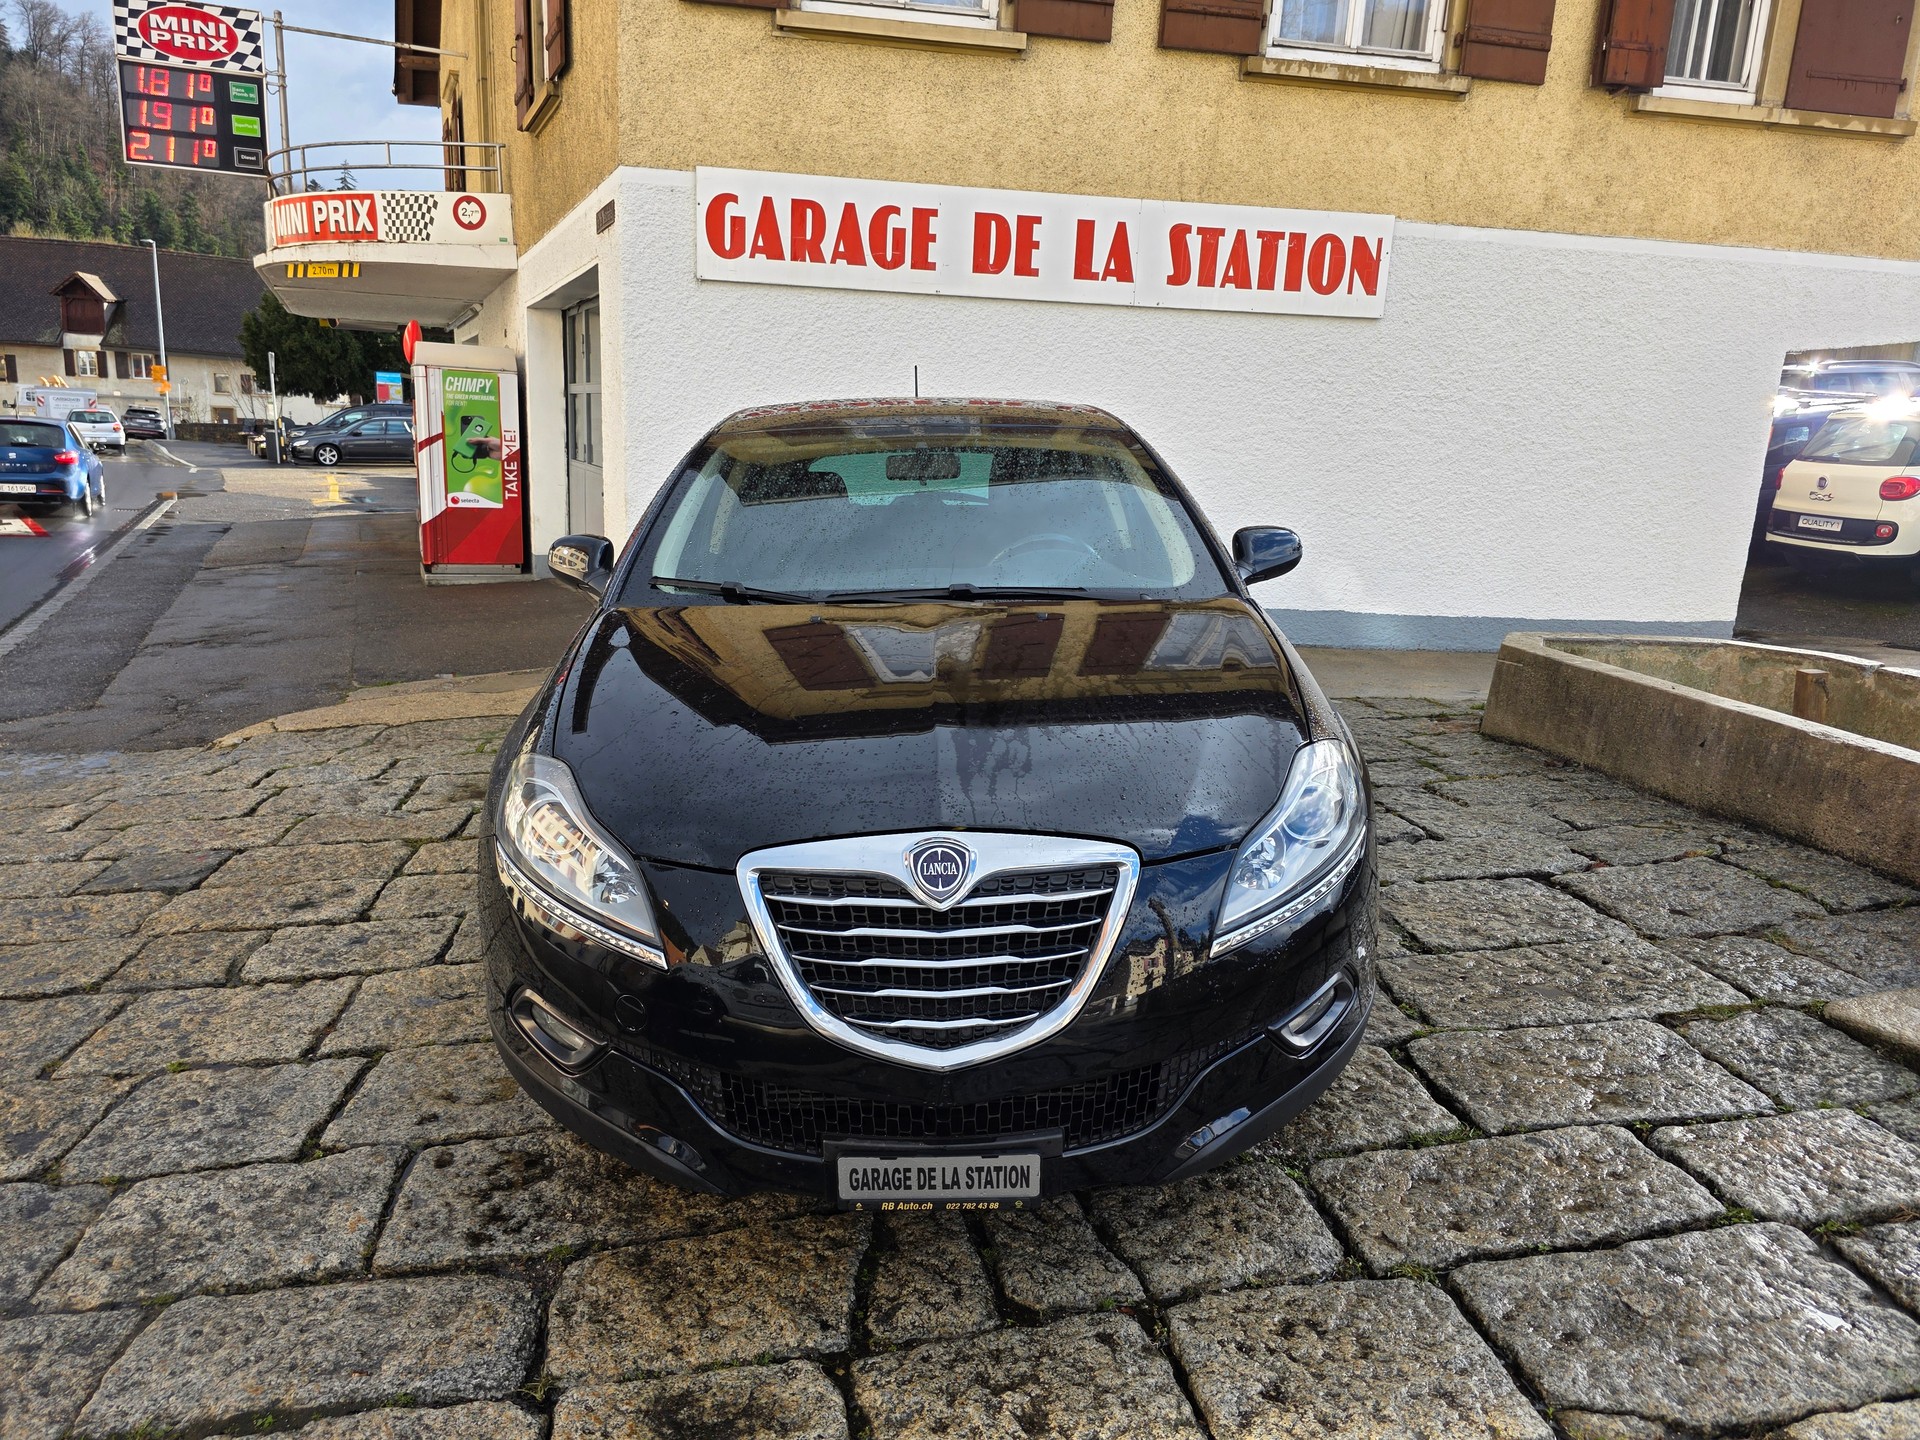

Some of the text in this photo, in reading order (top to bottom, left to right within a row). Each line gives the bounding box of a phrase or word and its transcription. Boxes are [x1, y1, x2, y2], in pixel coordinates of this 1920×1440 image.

[149, 14, 227, 38] MINI
[150, 29, 229, 54] PRIX
[275, 199, 374, 237] MINI PRIX
[705, 192, 1384, 296] GARAGE DE LA STATION
[445, 376, 493, 394] CHIMPY
[503, 430, 518, 500] TAKE ME!
[923, 862, 958, 875] LANCIA
[850, 1165, 1030, 1191] GARAGE DE LA STATION
[881, 1202, 895, 1211] RB
[897, 1202, 933, 1211] Auto.ch
[962, 1202, 976, 1210] 782
